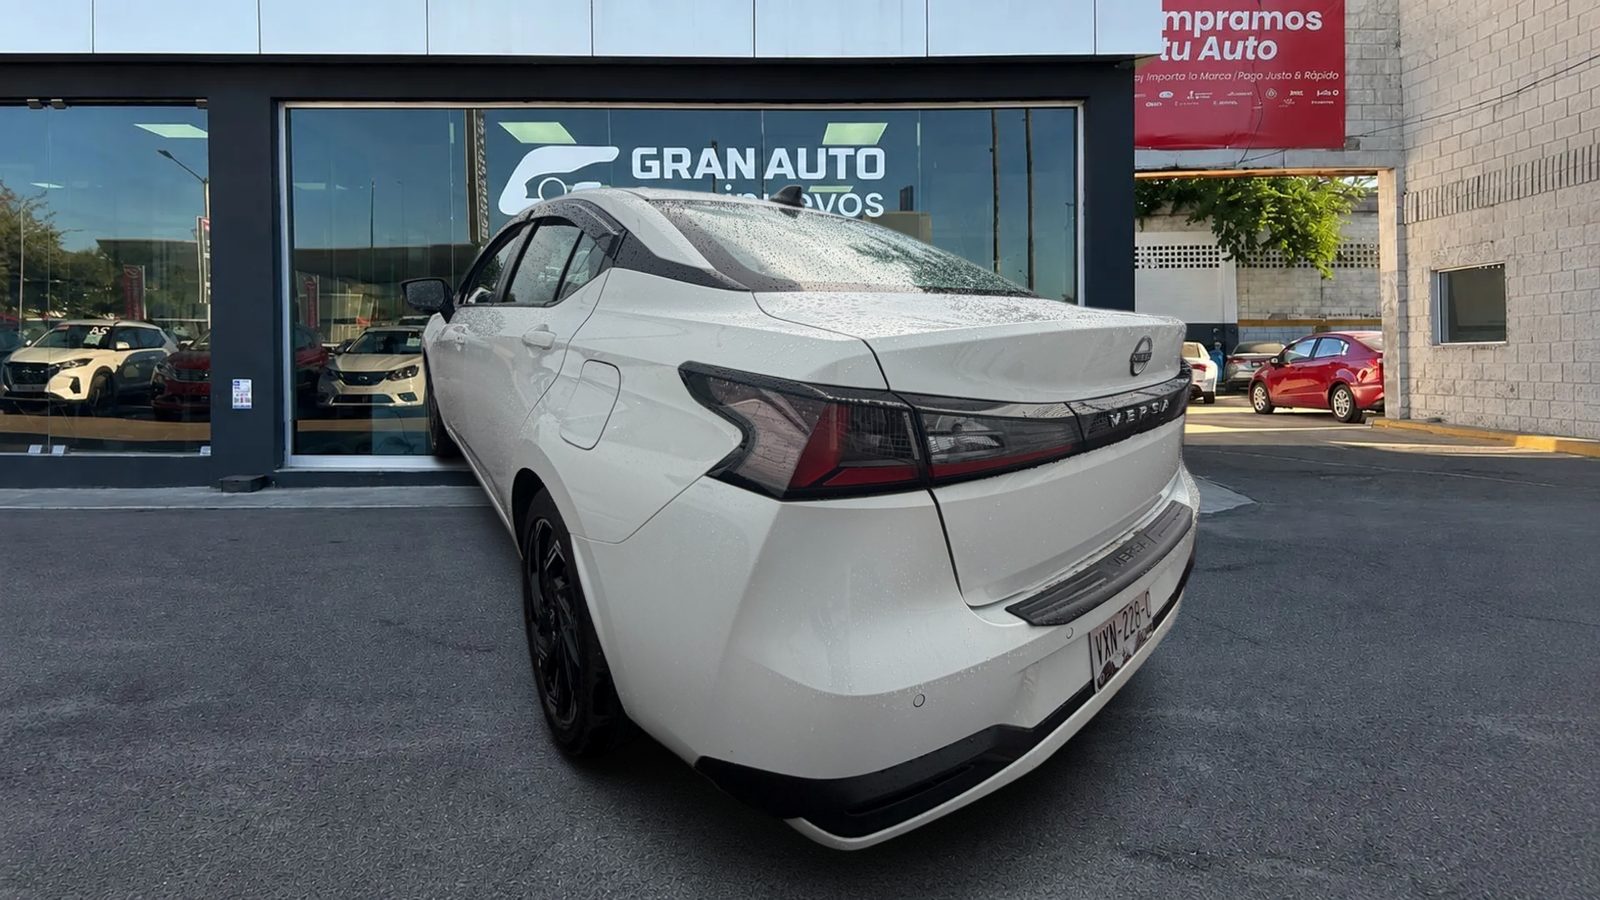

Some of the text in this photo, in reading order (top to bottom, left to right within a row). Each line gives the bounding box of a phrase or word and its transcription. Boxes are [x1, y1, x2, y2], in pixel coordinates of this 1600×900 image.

[1161, 10, 1323, 38] mpramos
[1160, 36, 1278, 61] tu Auto
[1146, 72, 1186, 83] Importa
[1189, 72, 1198, 80] la
[1200, 72, 1232, 80] Marca
[1266, 71, 1293, 80] Justo
[1294, 71, 1302, 80] &
[1304, 70, 1340, 82] Rápido
[631, 146, 885, 181] GRAN AUTO
